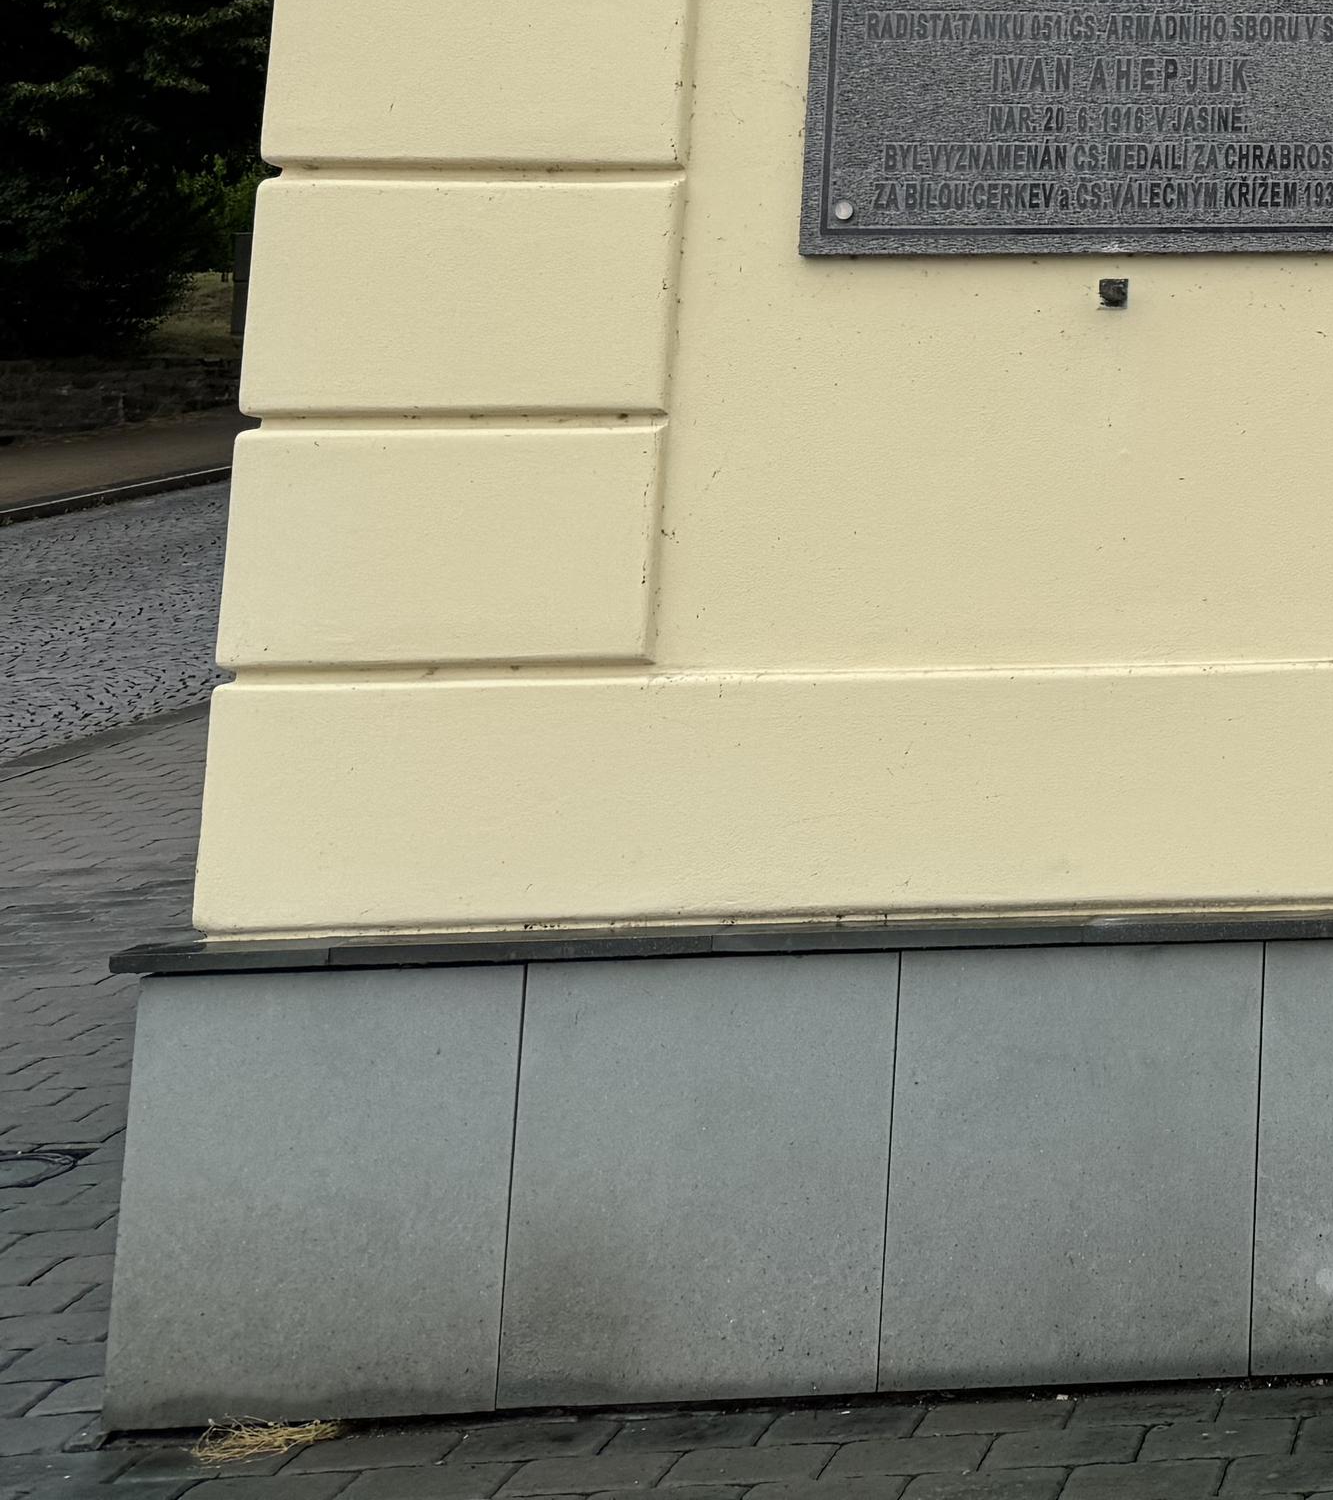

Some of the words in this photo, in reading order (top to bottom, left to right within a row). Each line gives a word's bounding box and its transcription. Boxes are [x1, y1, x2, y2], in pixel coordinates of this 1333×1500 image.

[866, 11, 954, 41] RADISTA
[956, 12, 1025, 42] TANKU
[1030, 13, 1062, 42] 051
[1232, 15, 1298, 43] SBORU
[1304, 15, 1318, 43] V
[992, 57, 1072, 93] IVAN
[1088, 57, 1249, 94] AHEPJUK
[1101, 106, 1145, 133] 1916
[1155, 106, 1167, 133] V
[884, 144, 924, 172] BYL
[1194, 144, 1219, 172] ZA
[874, 183, 900, 211] ZA
[972, 183, 1055, 210] CERKEV
[1058, 187, 1070, 210] a
[1110, 175, 1219, 210] VÁLEČNÝM
[1224, 175, 1298, 209] KŘÍŽEM
